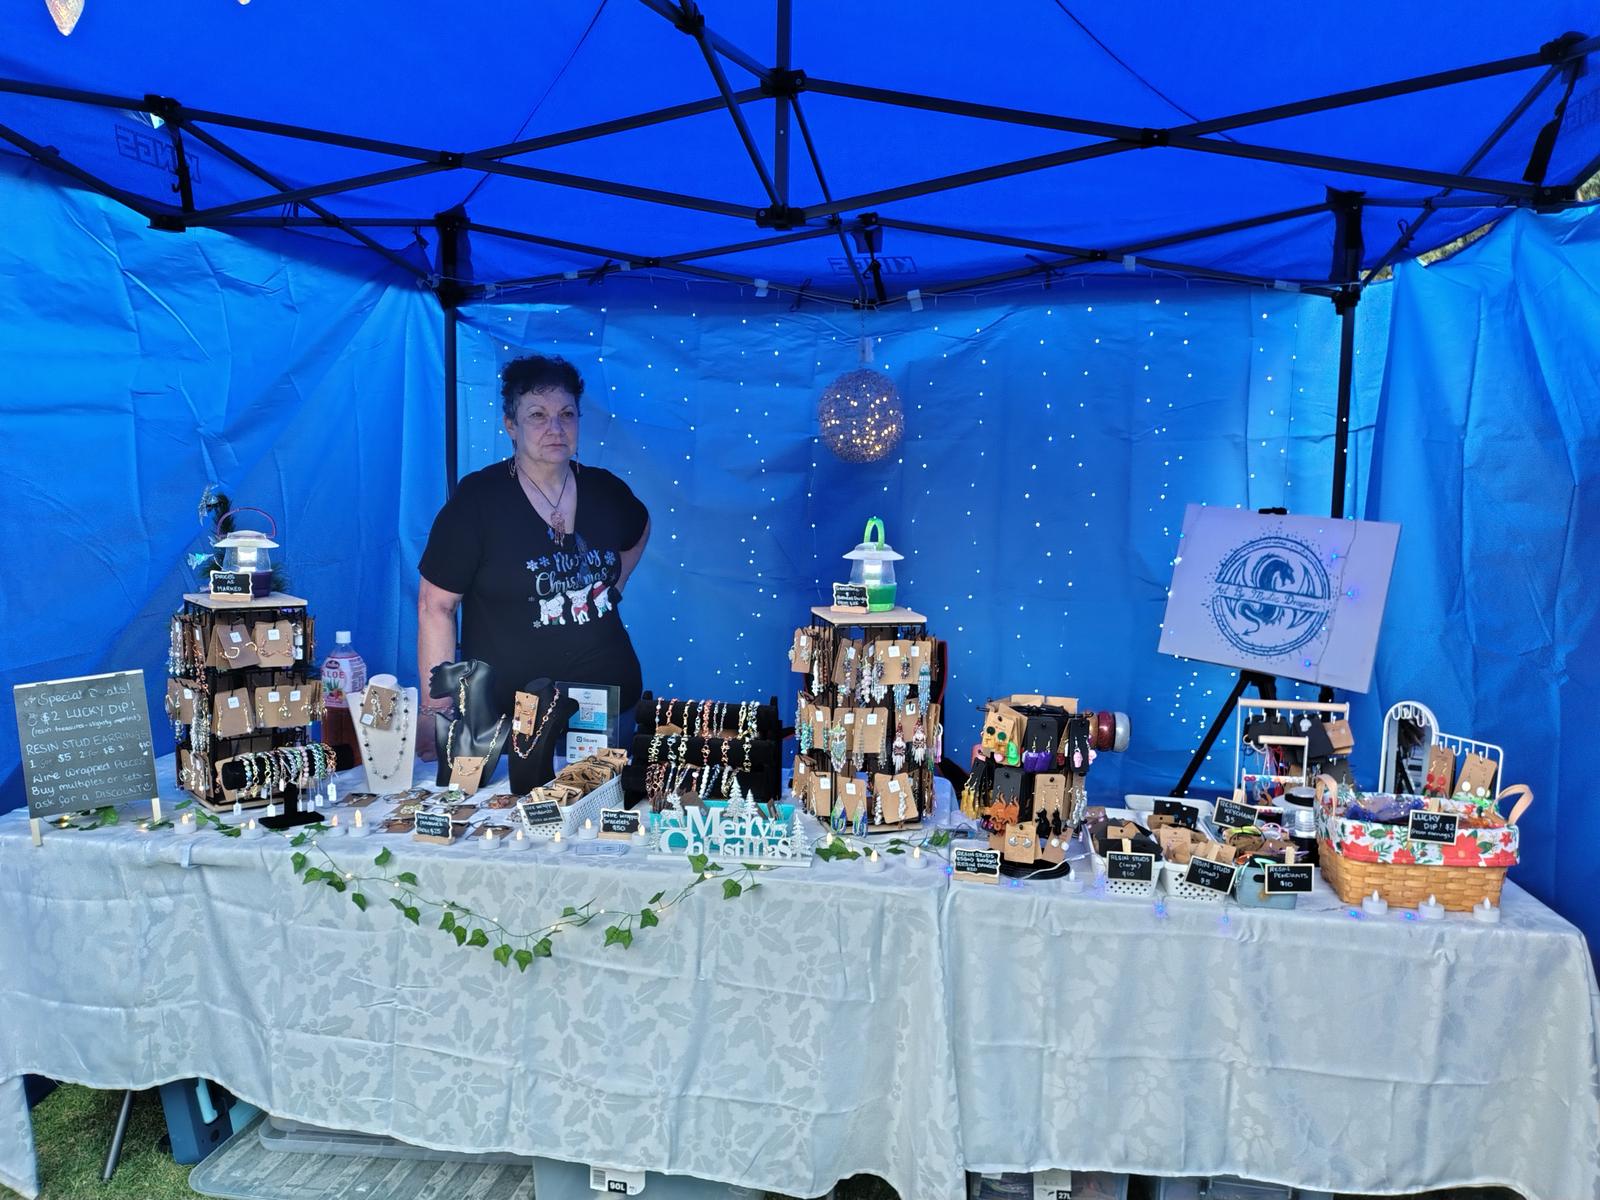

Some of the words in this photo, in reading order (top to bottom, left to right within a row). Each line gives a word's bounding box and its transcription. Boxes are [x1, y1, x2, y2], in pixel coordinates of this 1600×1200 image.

[37, 690, 82, 707] Special
[40, 711, 61, 725] $2
[65, 704, 104, 720] LUCKY
[26, 743, 59, 756] RESIN
[62, 737, 90, 750] STUD
[30, 760, 37, 769] 1
[57, 753, 72, 763] $5
[79, 751, 86, 759] 2
[31, 785, 55, 797] Buy
[59, 778, 104, 791] multiples
[107, 775, 118, 783] or
[34, 799, 54, 809] ask
[59, 796, 77, 808] for
[95, 785, 142, 800] DISCOUNT
[1412, 813, 1441, 823] LUCKY
